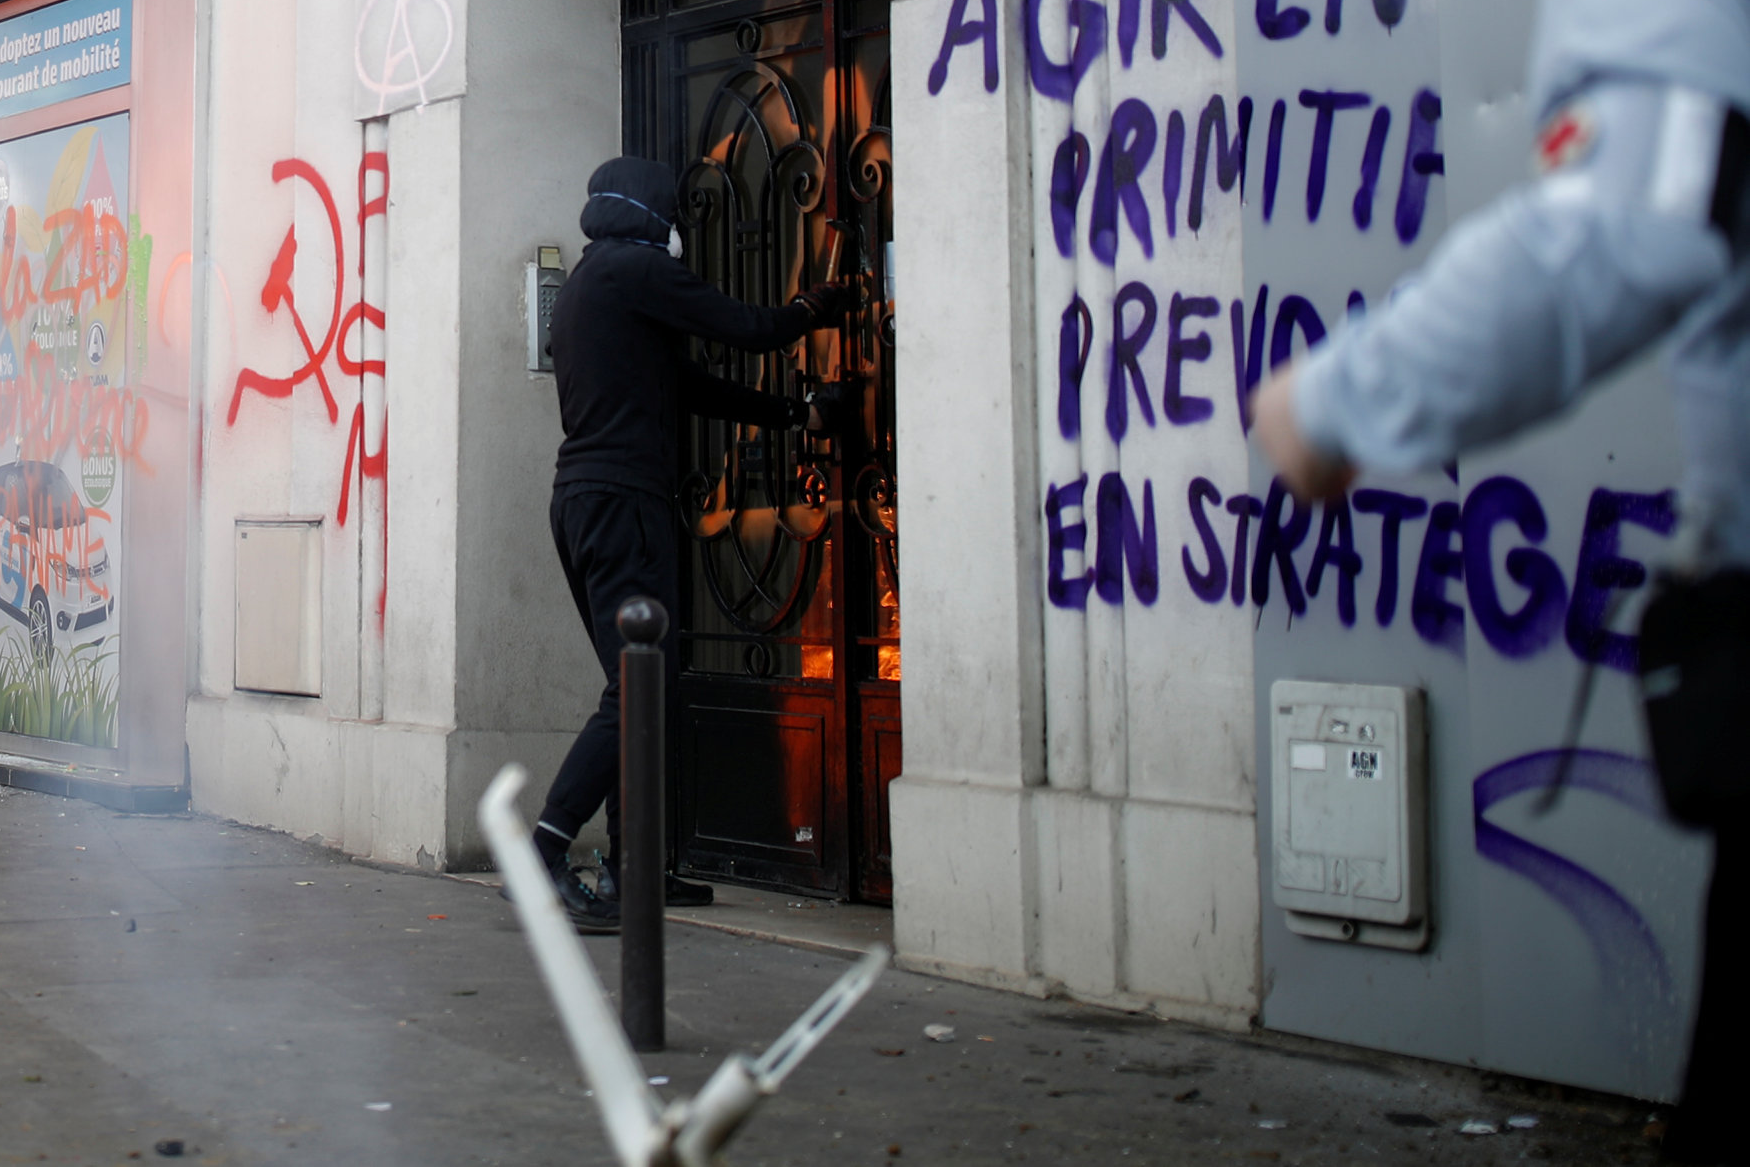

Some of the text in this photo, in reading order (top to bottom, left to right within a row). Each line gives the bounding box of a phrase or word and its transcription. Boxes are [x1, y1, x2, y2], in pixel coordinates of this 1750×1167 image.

[44, 26, 60, 50] un
[63, 7, 121, 44] nouveau
[42, 59, 57, 87] de
[60, 38, 120, 82] mobilité
[43, 202, 128, 315] ZAD
[83, 455, 114, 476] BONUS
[1046, 470, 1159, 609] EN
